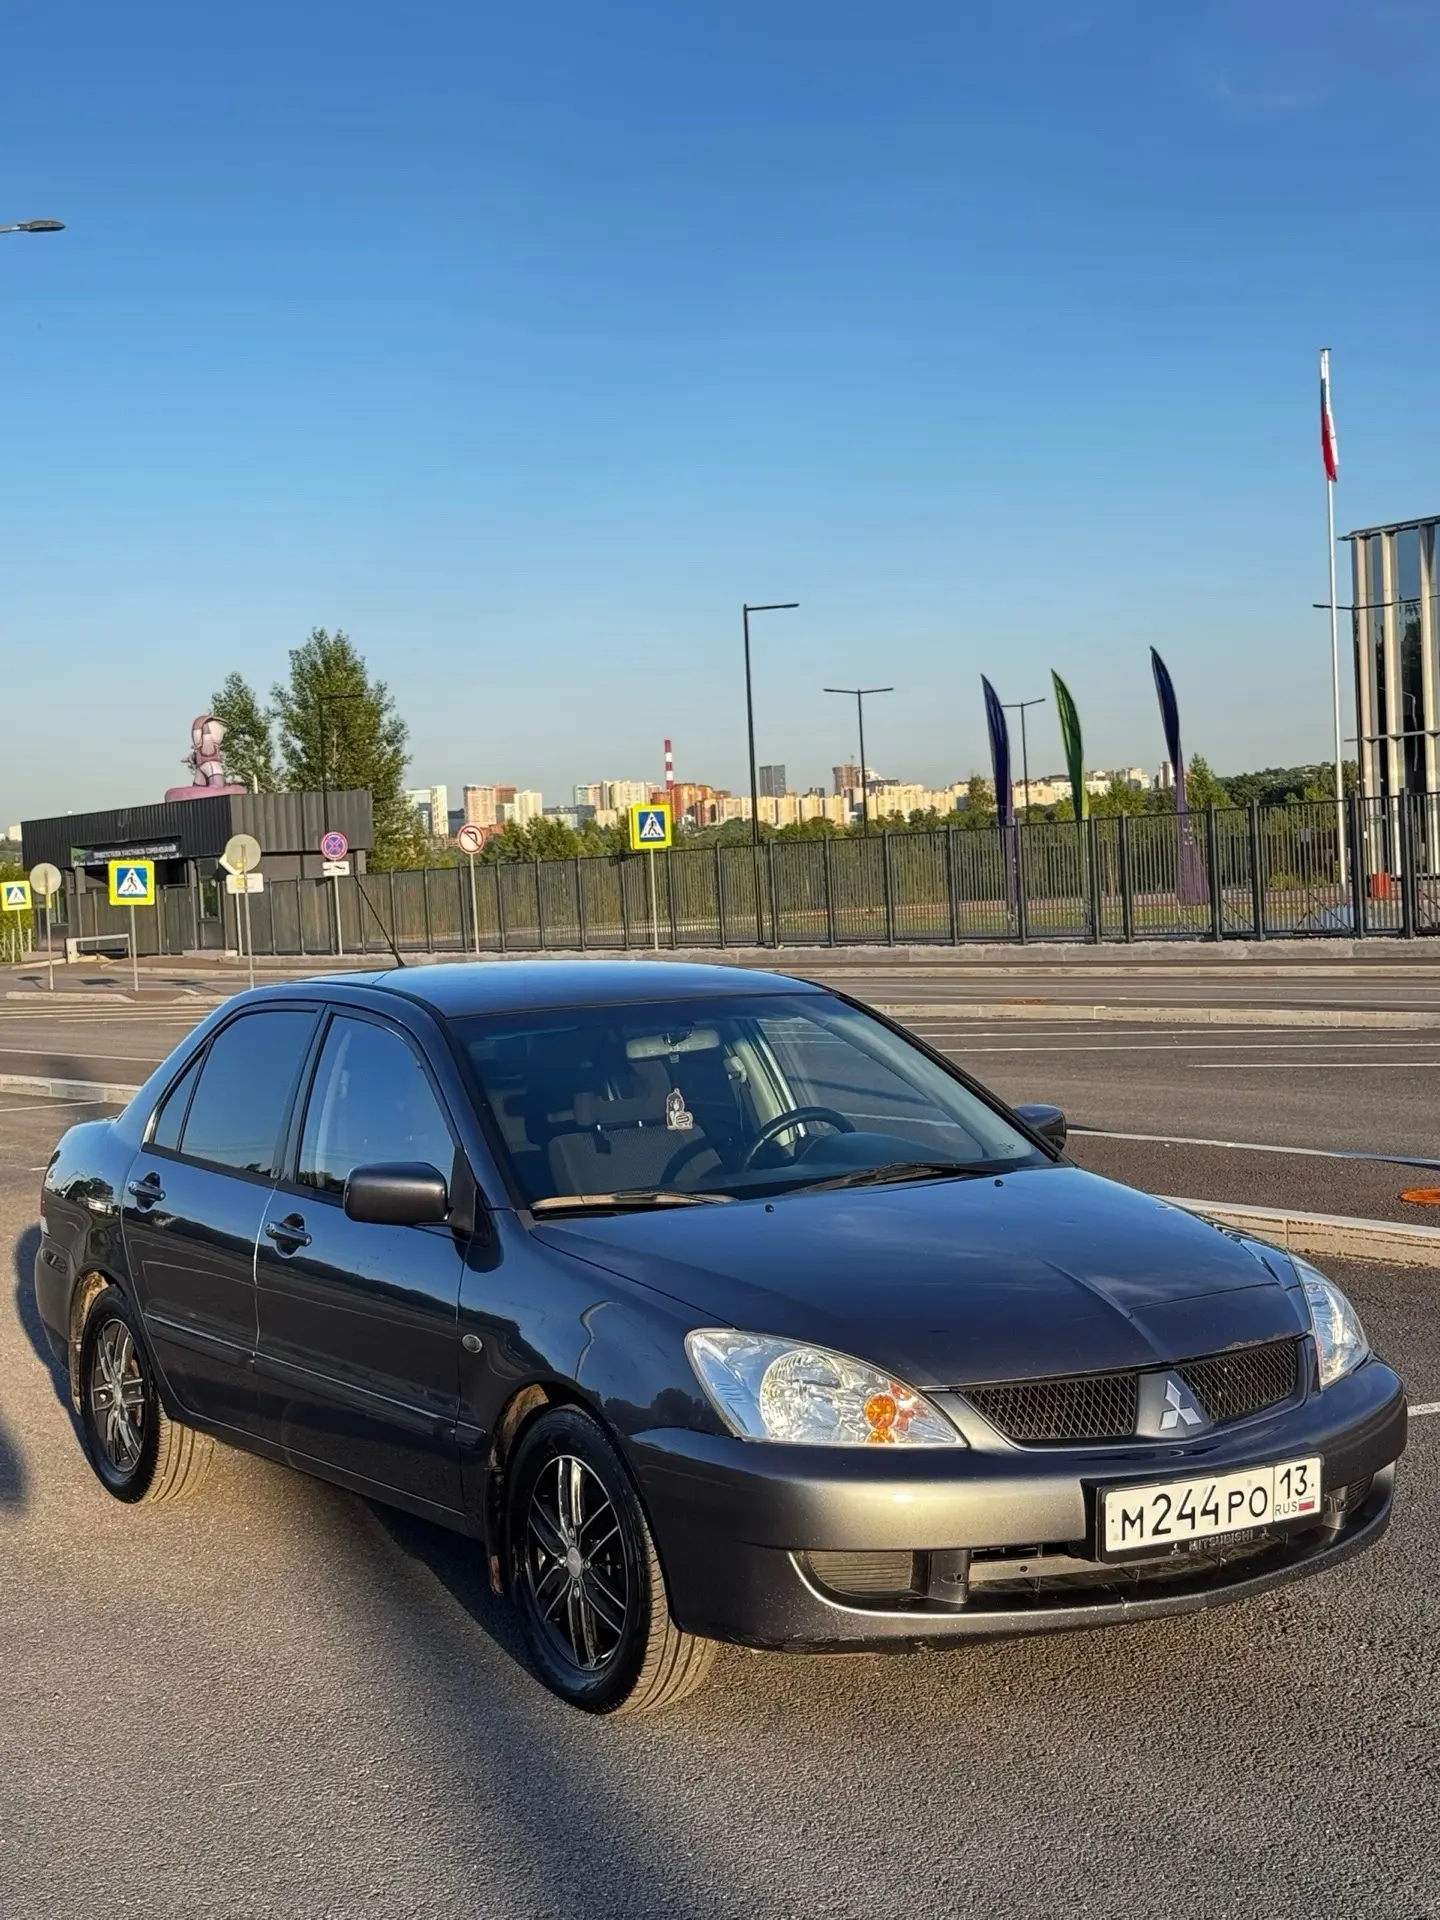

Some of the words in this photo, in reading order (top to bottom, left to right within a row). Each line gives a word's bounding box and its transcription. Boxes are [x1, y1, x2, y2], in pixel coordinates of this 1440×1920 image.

[1121, 1485, 1268, 1541] М244РО
[1279, 1465, 1308, 1499] 13
[1275, 1501, 1298, 1516] RUS
[1189, 1529, 1254, 1552] MITSUBISHI
